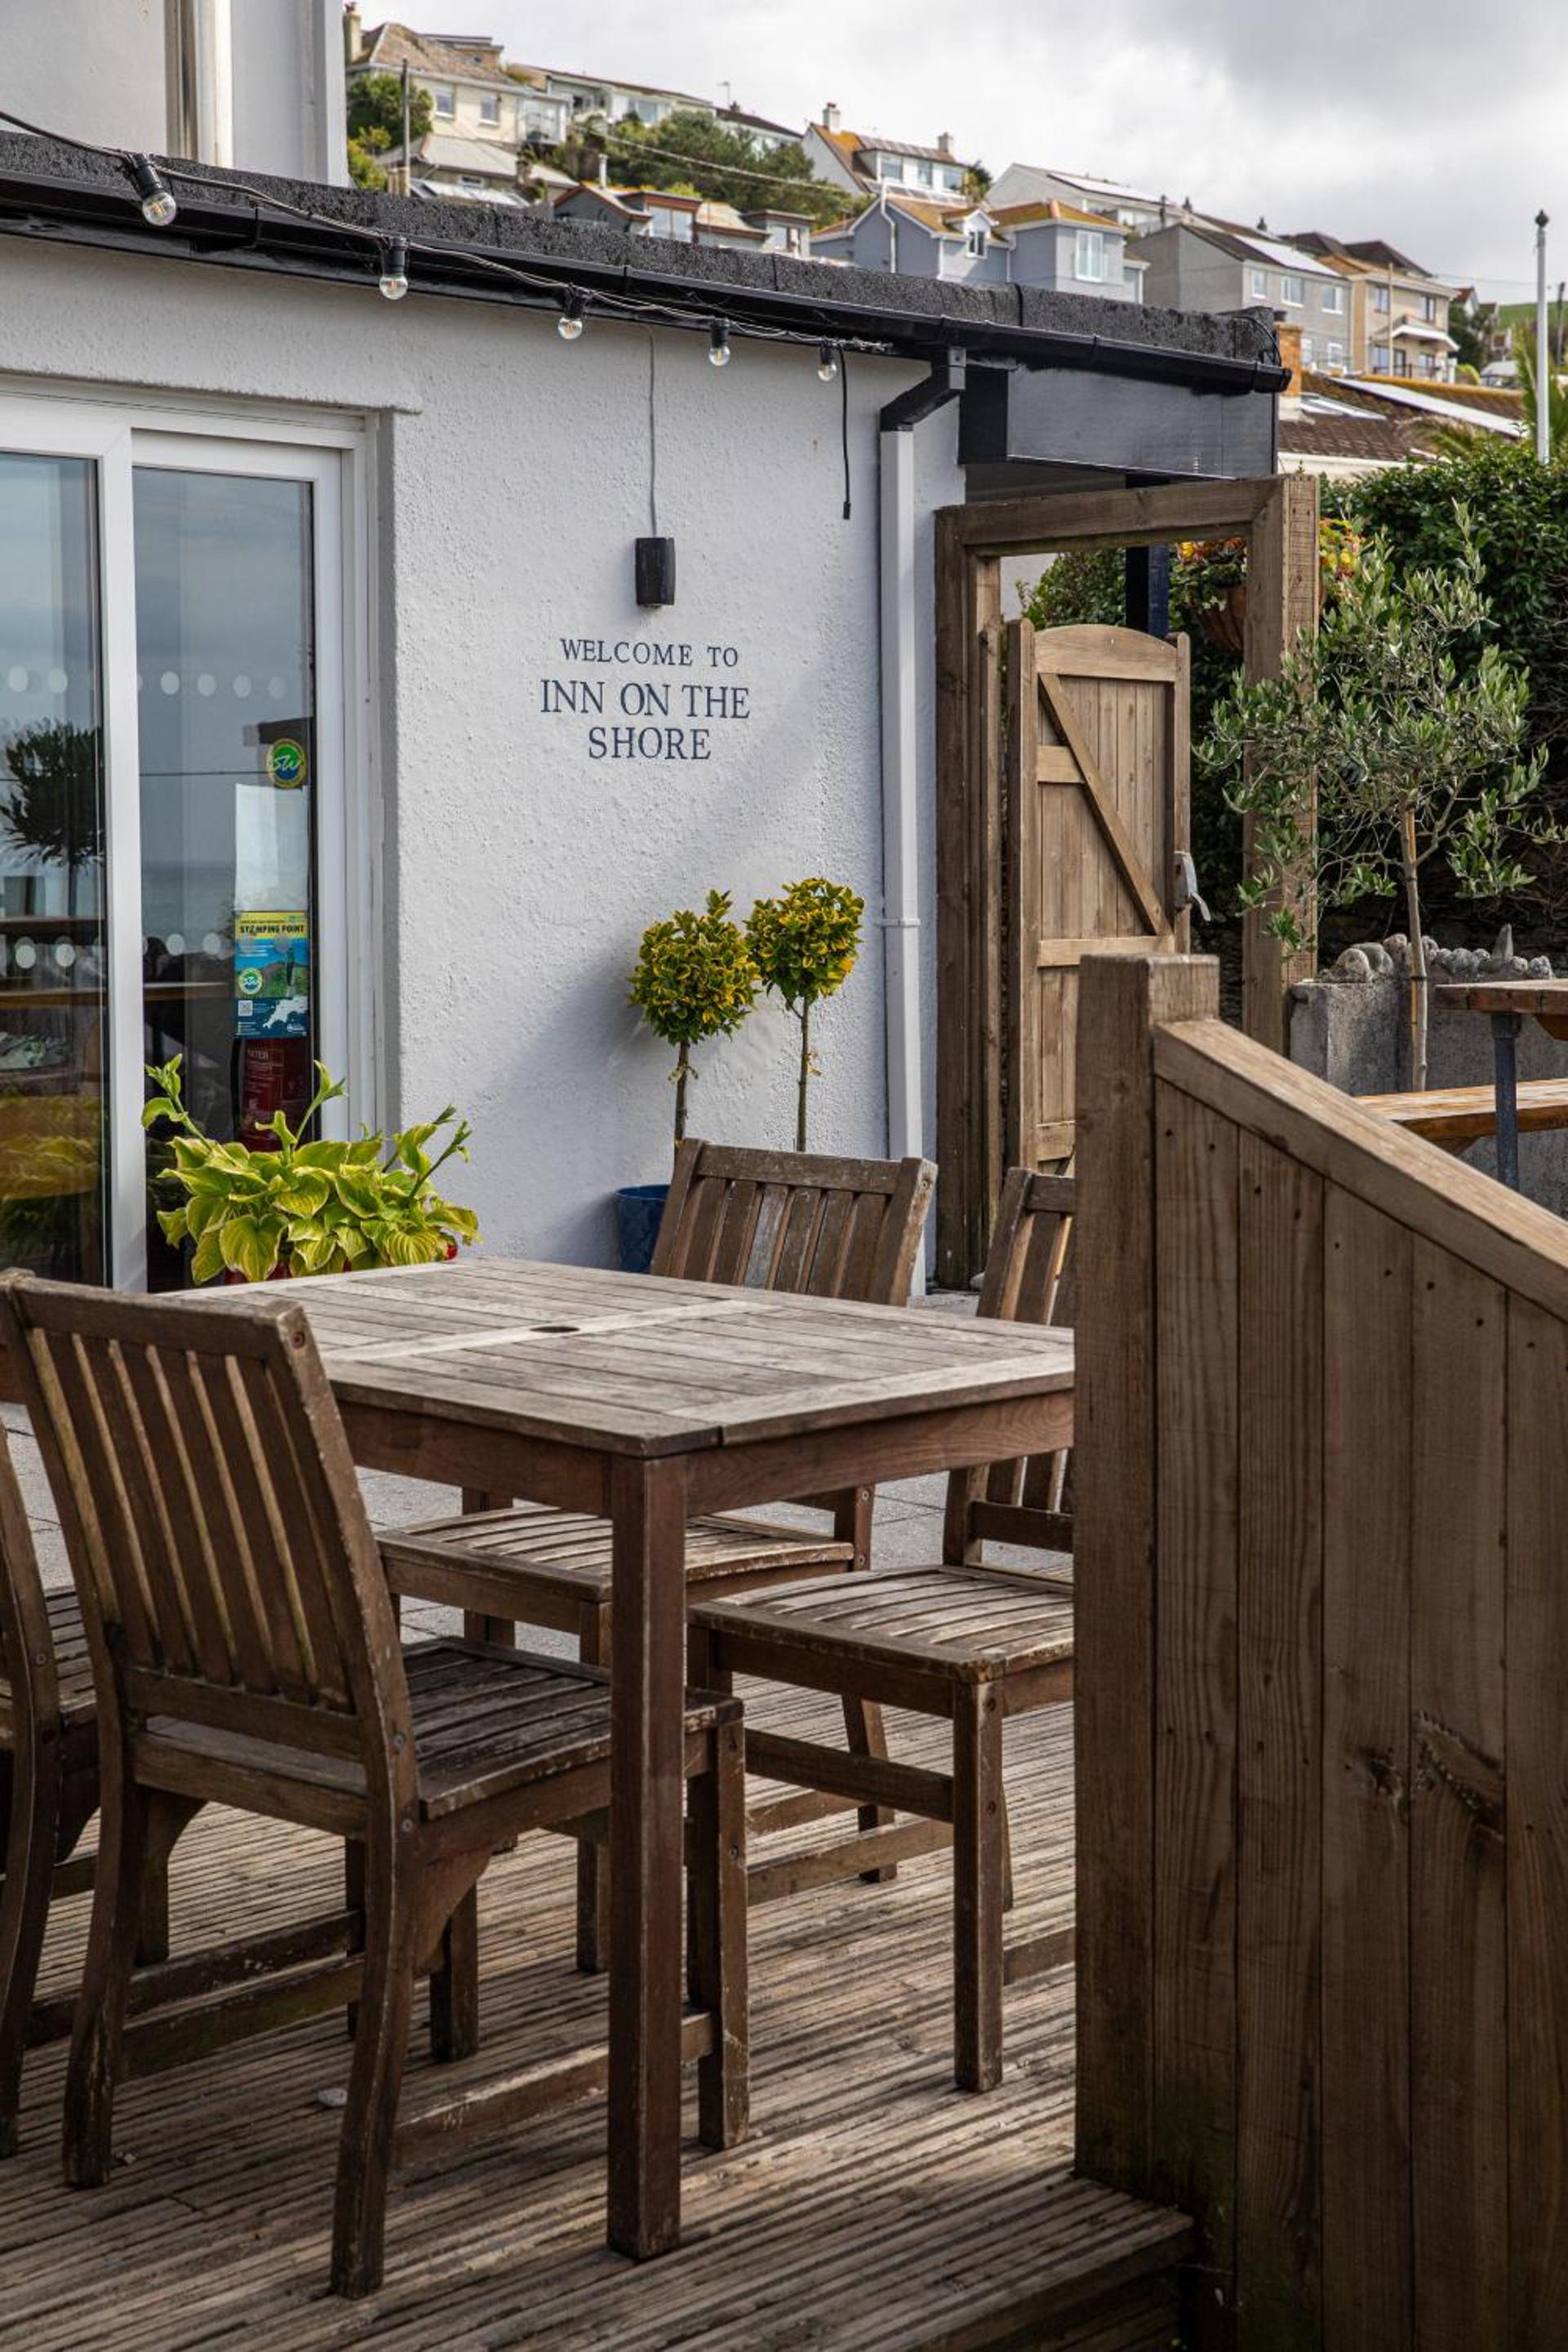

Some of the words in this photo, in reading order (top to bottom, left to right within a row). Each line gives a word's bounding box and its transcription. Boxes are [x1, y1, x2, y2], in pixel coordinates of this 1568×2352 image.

[560, 638, 693, 665] WELCOME
[707, 647, 739, 667] TO
[540, 679, 606, 714] INN
[620, 682, 671, 716] ON
[682, 685, 751, 718] THE
[589, 727, 711, 760] SHORE
[282, 923, 304, 932] POINT
